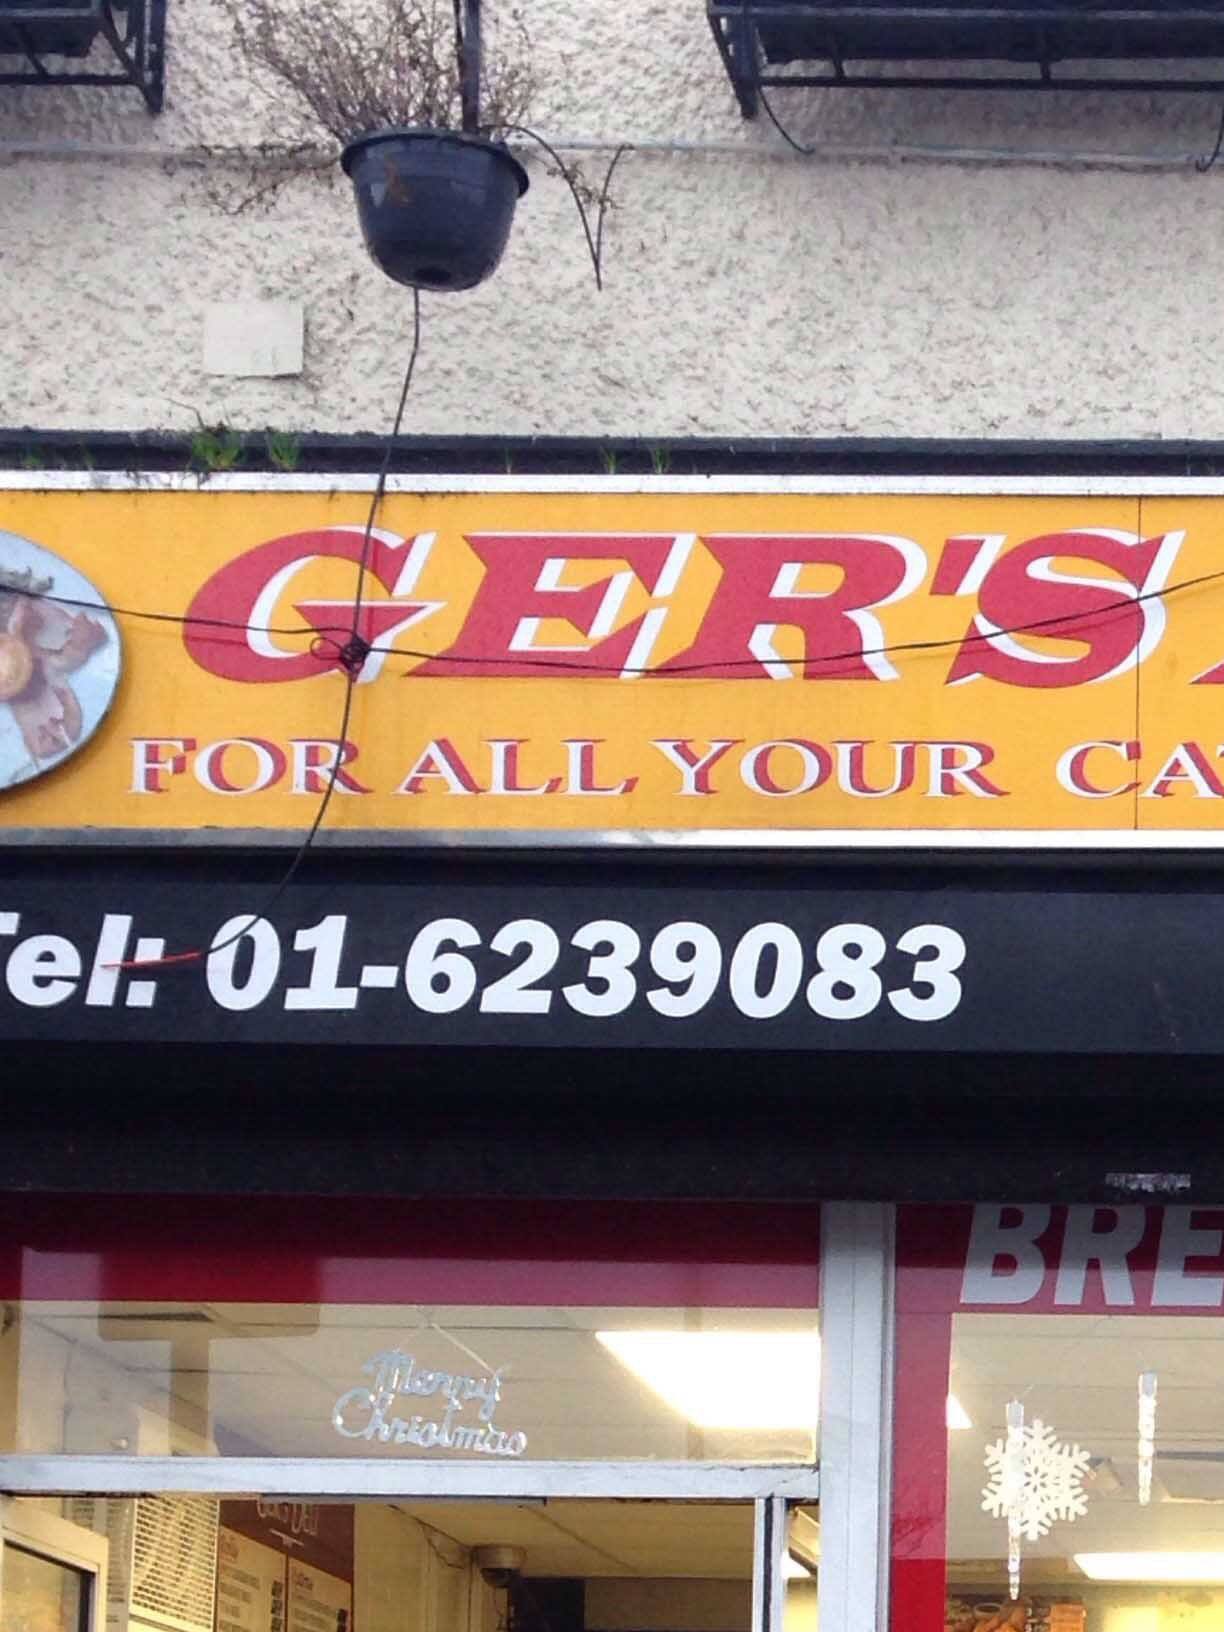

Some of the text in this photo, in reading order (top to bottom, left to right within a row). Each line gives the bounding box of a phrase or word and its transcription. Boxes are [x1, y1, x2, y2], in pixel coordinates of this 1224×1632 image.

[182, 526, 1187, 688] GER'S
[127, 737, 372, 797] FOR
[395, 737, 640, 797] ALL
[648, 738, 1010, 798] YOUR
[0, 911, 969, 1022] el: 01-6239083
